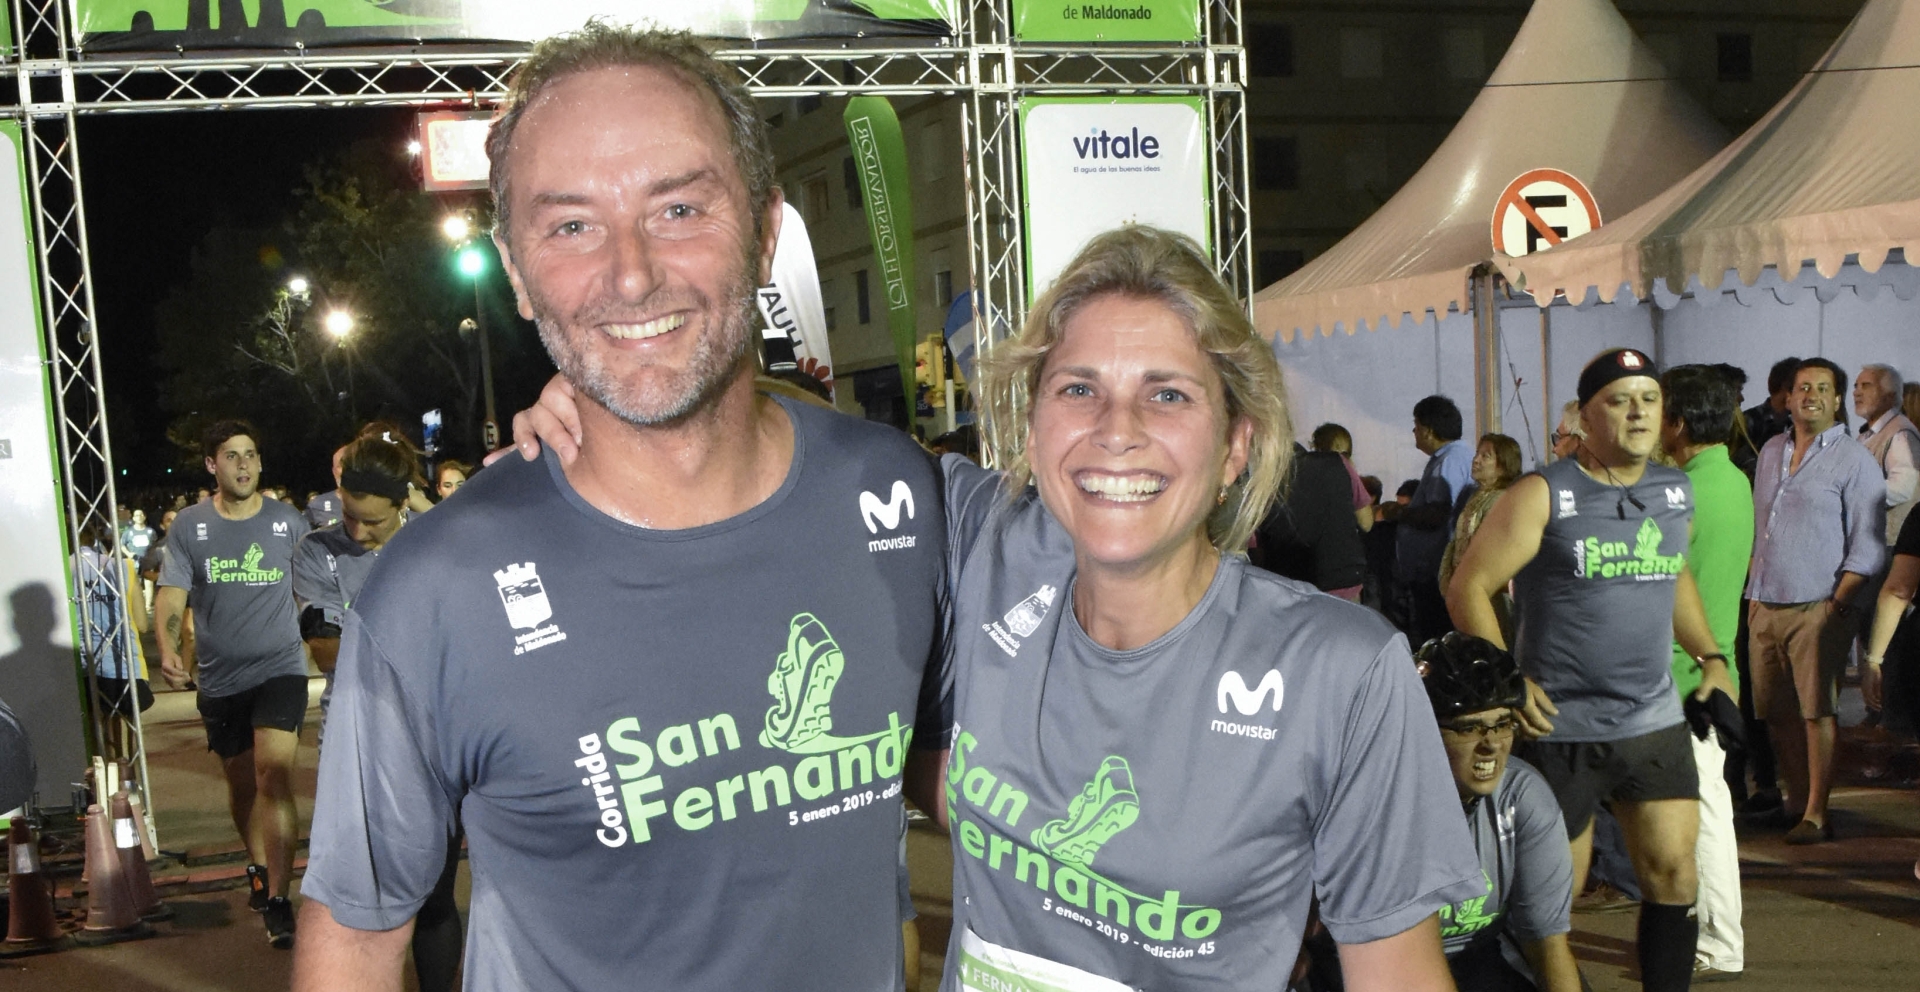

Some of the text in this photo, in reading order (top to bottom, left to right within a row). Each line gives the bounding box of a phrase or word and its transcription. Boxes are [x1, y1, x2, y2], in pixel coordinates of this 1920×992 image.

[1063, 5, 1152, 20] de Maldonado
[1073, 126, 1160, 160] vitale
[868, 535, 916, 553] movistar
[1585, 536, 1629, 558] San
[210, 556, 238, 570] San
[212, 567, 284, 583] Fernando
[1585, 552, 1684, 580] Fernand
[981, 623, 1018, 657] de Maldonado
[991, 620, 1021, 649] Intendencia
[514, 645, 525, 656] de
[1210, 719, 1278, 740] movistar
[606, 713, 741, 780] San
[574, 732, 628, 848] Corrida
[948, 731, 1029, 828] San
[788, 810, 799, 826] 5
[802, 804, 840, 823] enero
[842, 790, 874, 812] 2019
[882, 779, 903, 800] edici
[1042, 897, 1053, 911] 5
[1055, 905, 1093, 927] enero
[1096, 920, 1130, 944] 2019
[1143, 943, 1194, 959] edición
[1197, 941, 1216, 955] 45
[973, 967, 1033, 992] FERN
